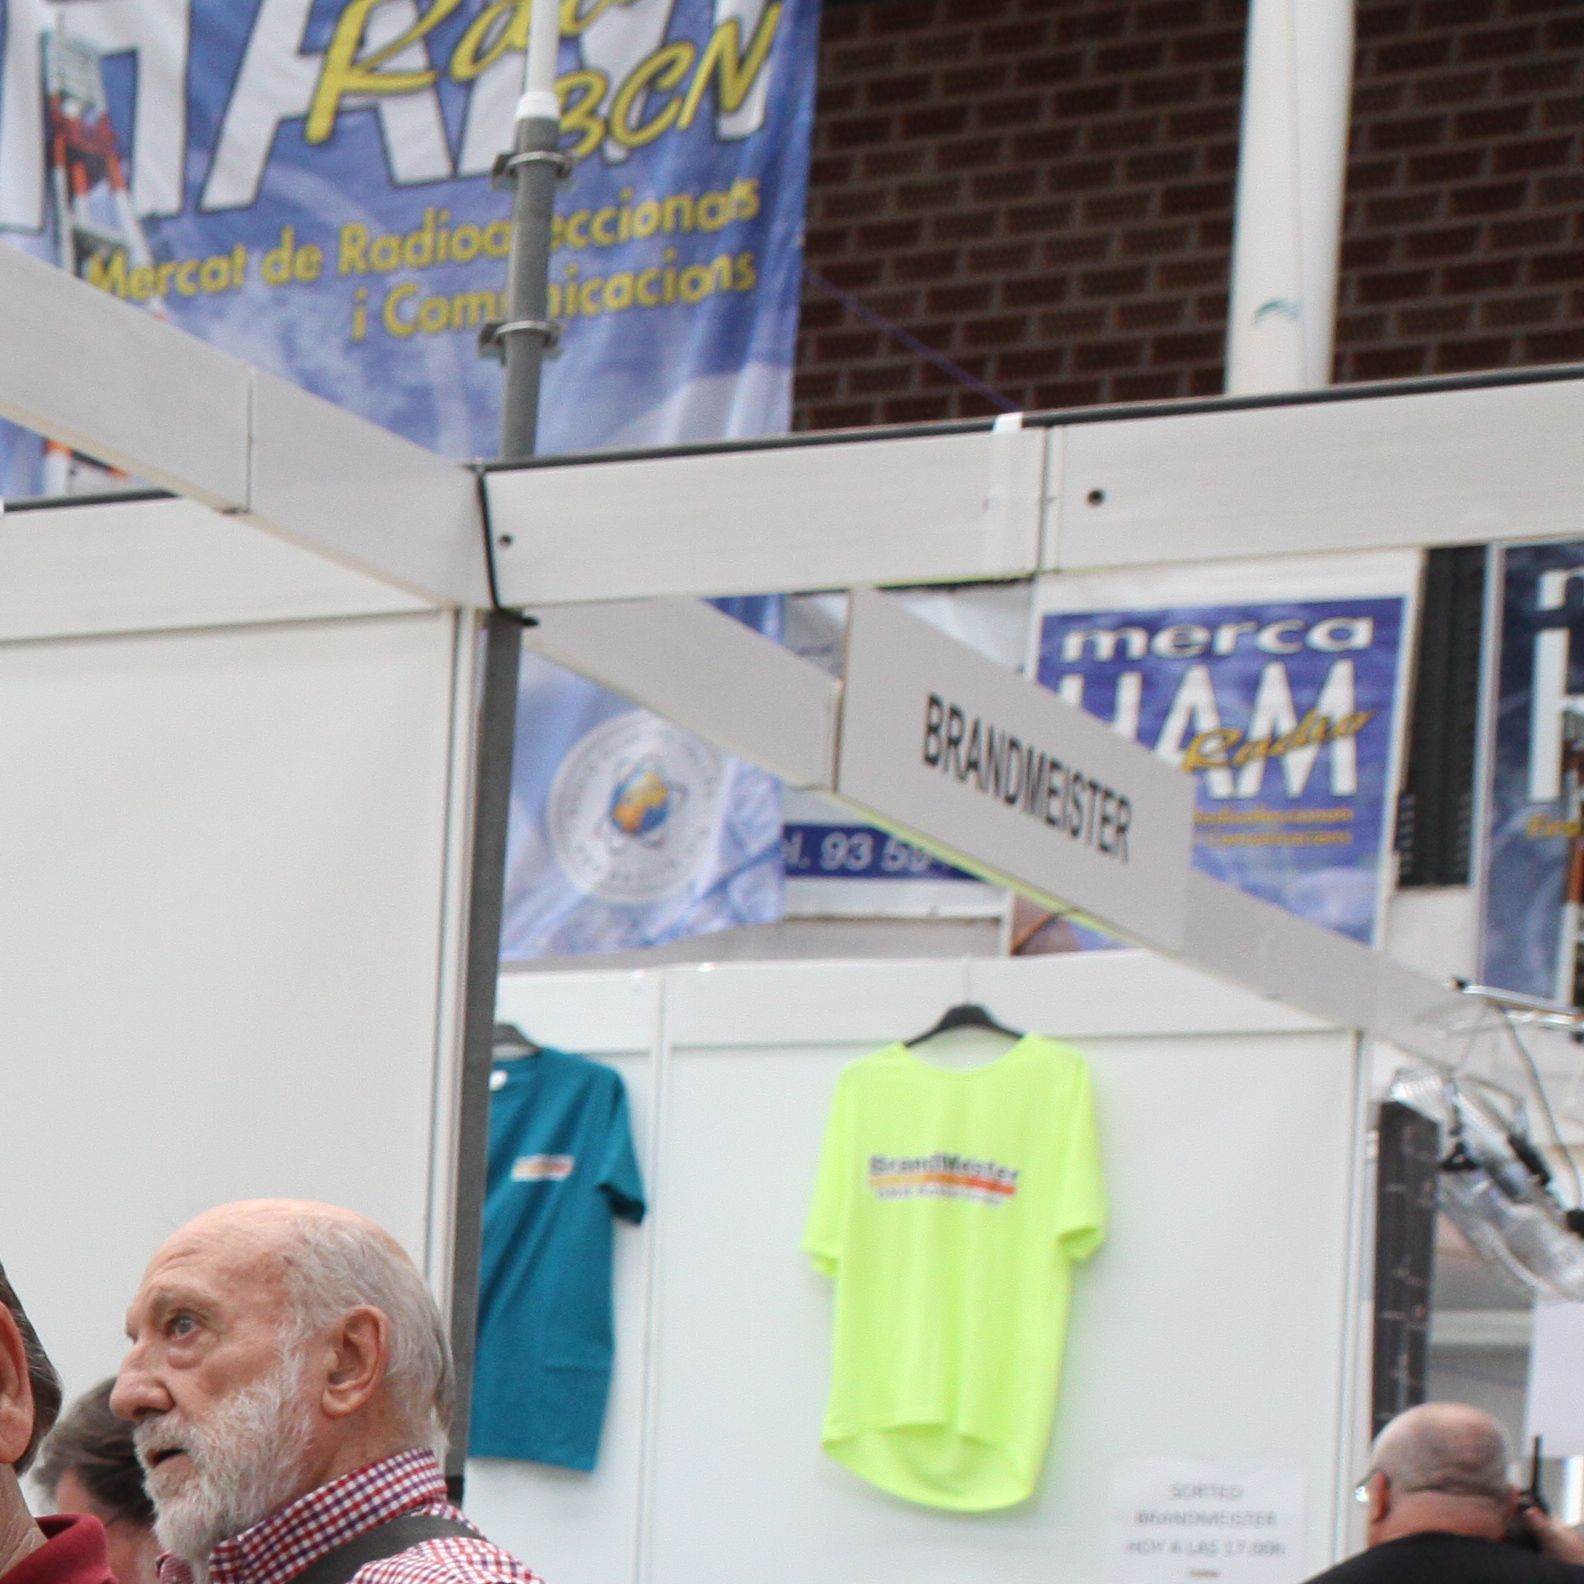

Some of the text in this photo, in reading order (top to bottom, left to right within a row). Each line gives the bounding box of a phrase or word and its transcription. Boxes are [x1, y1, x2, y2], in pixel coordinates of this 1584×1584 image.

[88, 242, 247, 299] Mercat
[261, 225, 323, 286] de
[351, 288, 368, 342] i
[1060, 615, 1375, 664] merca
[1180, 708, 1377, 774] Radio
[922, 693, 1131, 865] BRANDMEISTER
[820, 831, 874, 872] 93
